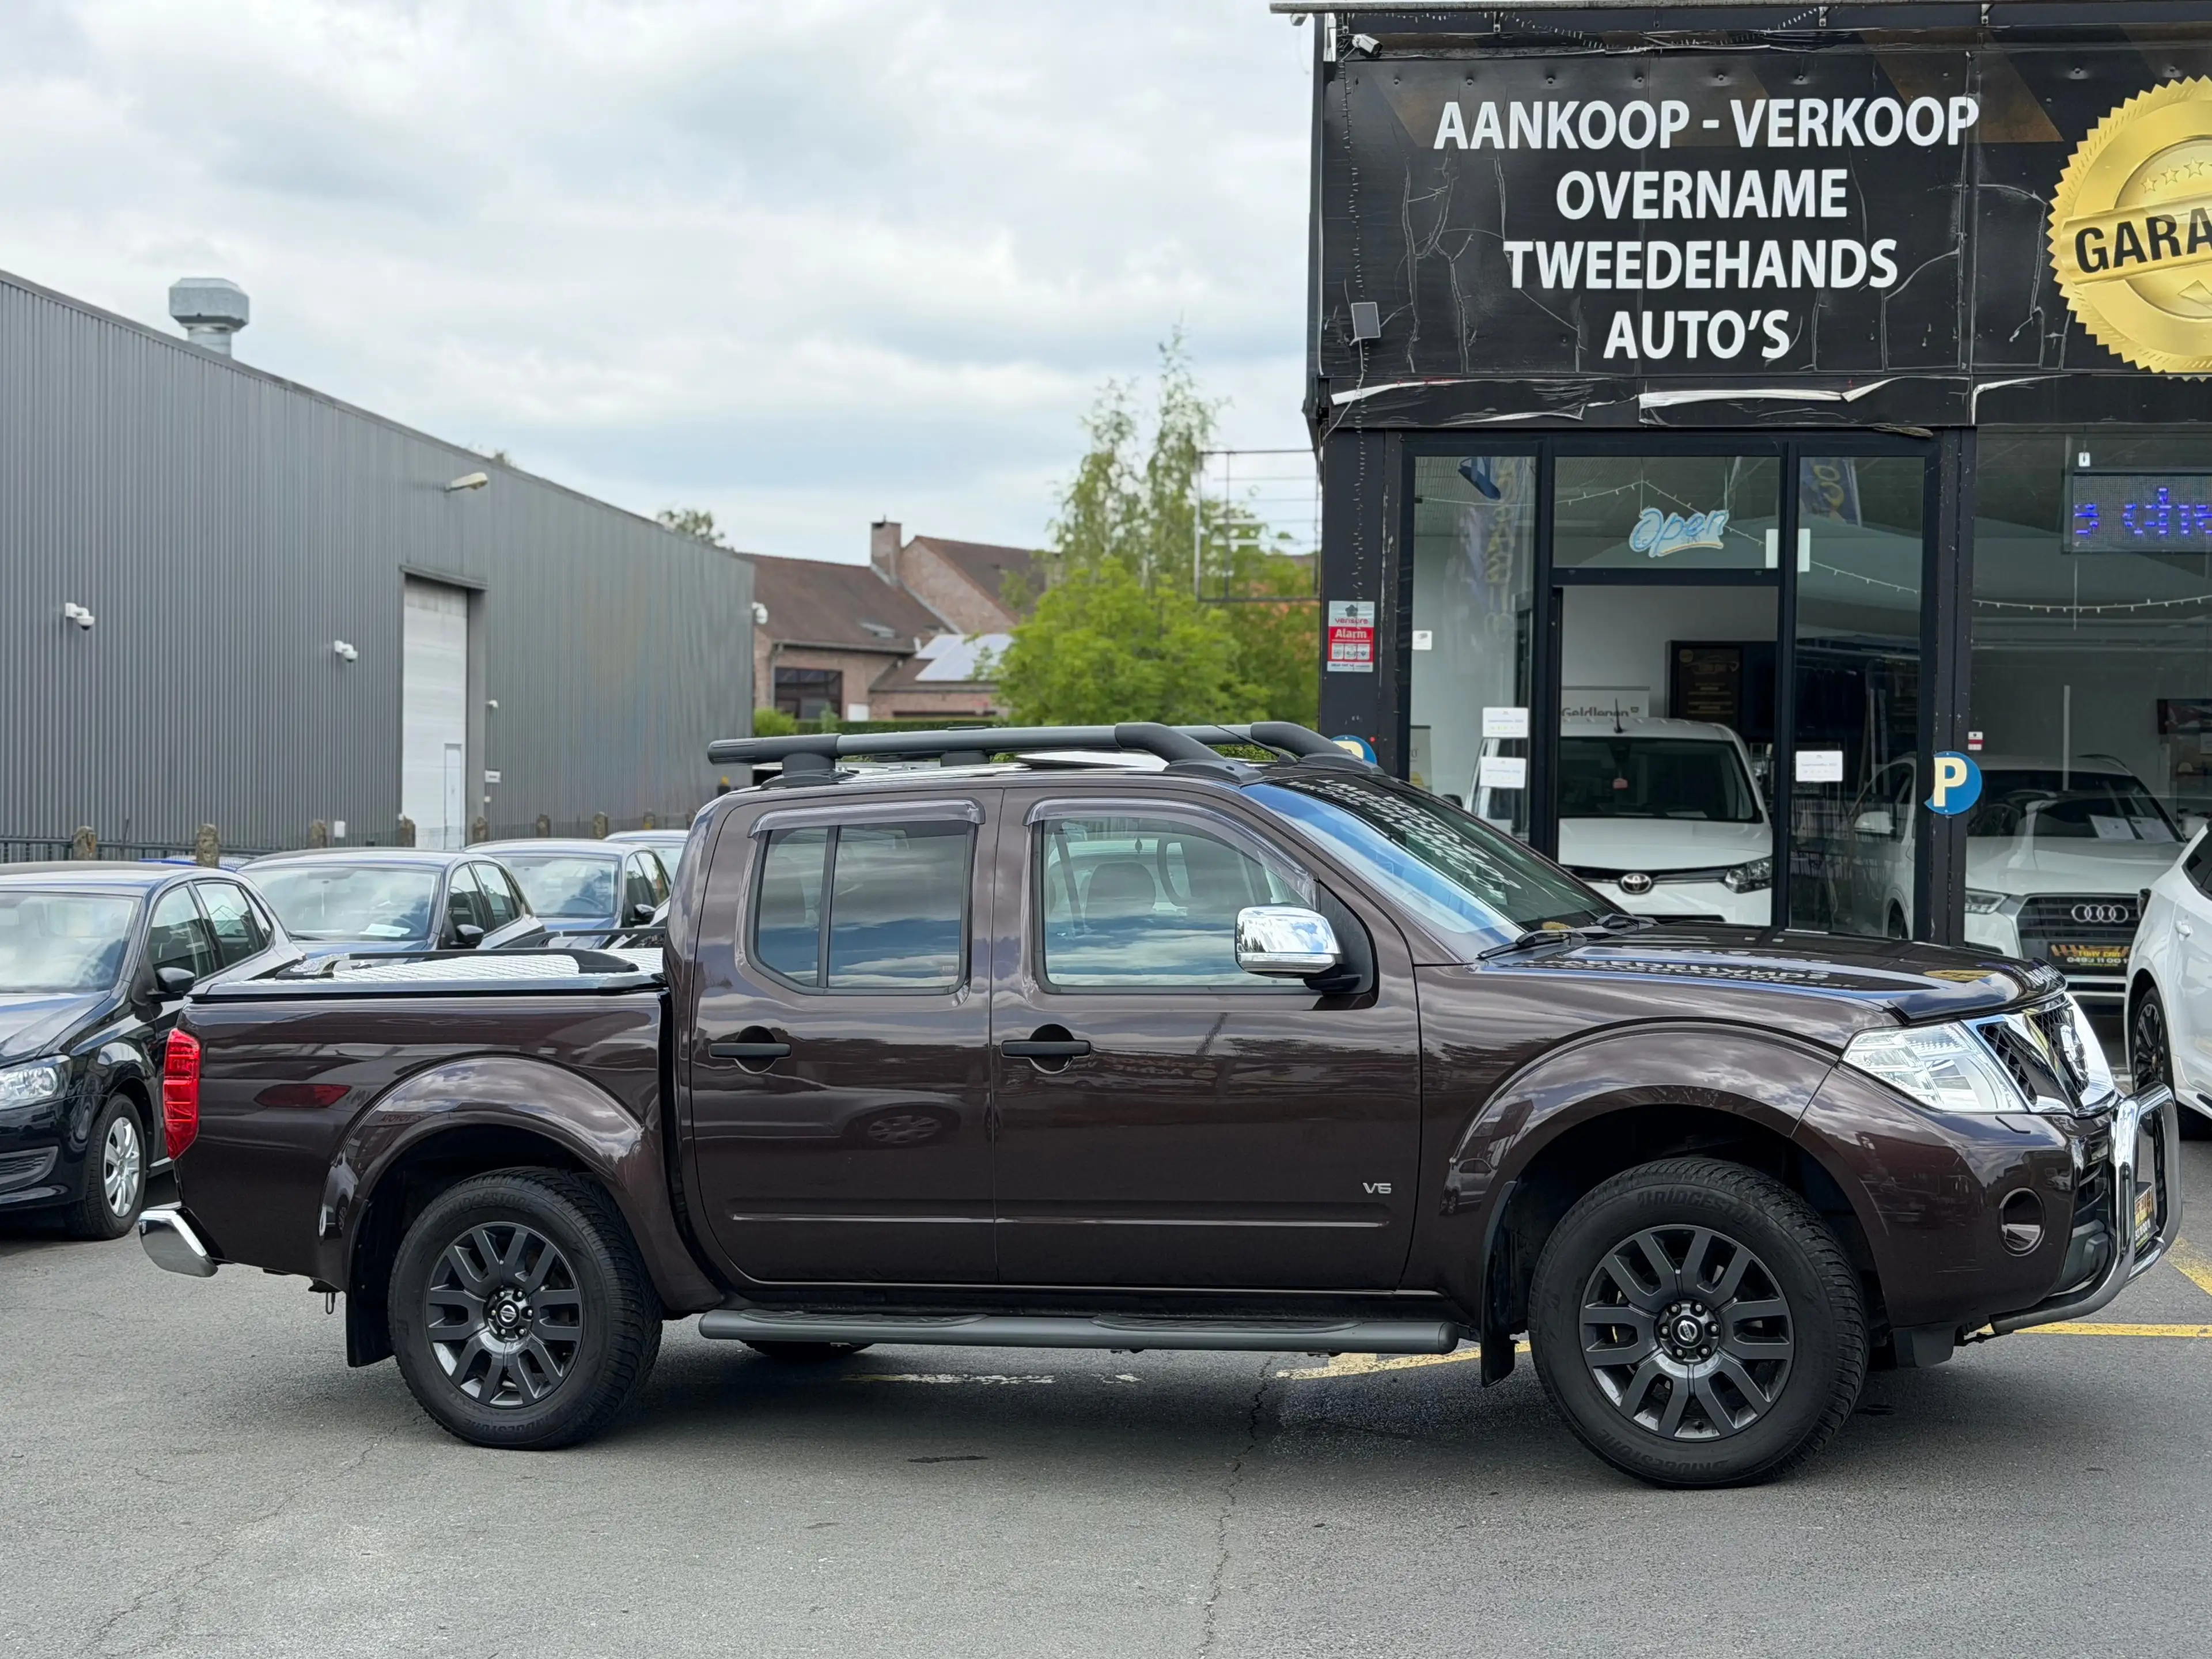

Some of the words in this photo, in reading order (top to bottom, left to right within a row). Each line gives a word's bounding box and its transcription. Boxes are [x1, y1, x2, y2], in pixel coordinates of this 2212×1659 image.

[1433, 100, 1690, 150] AANKOOP
[1703, 119, 1719, 128] -
[1729, 96, 1980, 147] VERKOOP
[1556, 169, 1847, 219] OVERNAME
[1502, 238, 1897, 289] TWEEDEHANDS
[1603, 309, 1789, 359] AUTO'S
[1631, 509, 1728, 556] Open
[1335, 628, 1367, 639] Alarm
[1933, 757, 1967, 806] P
[1362, 1182, 1392, 1194] V6
